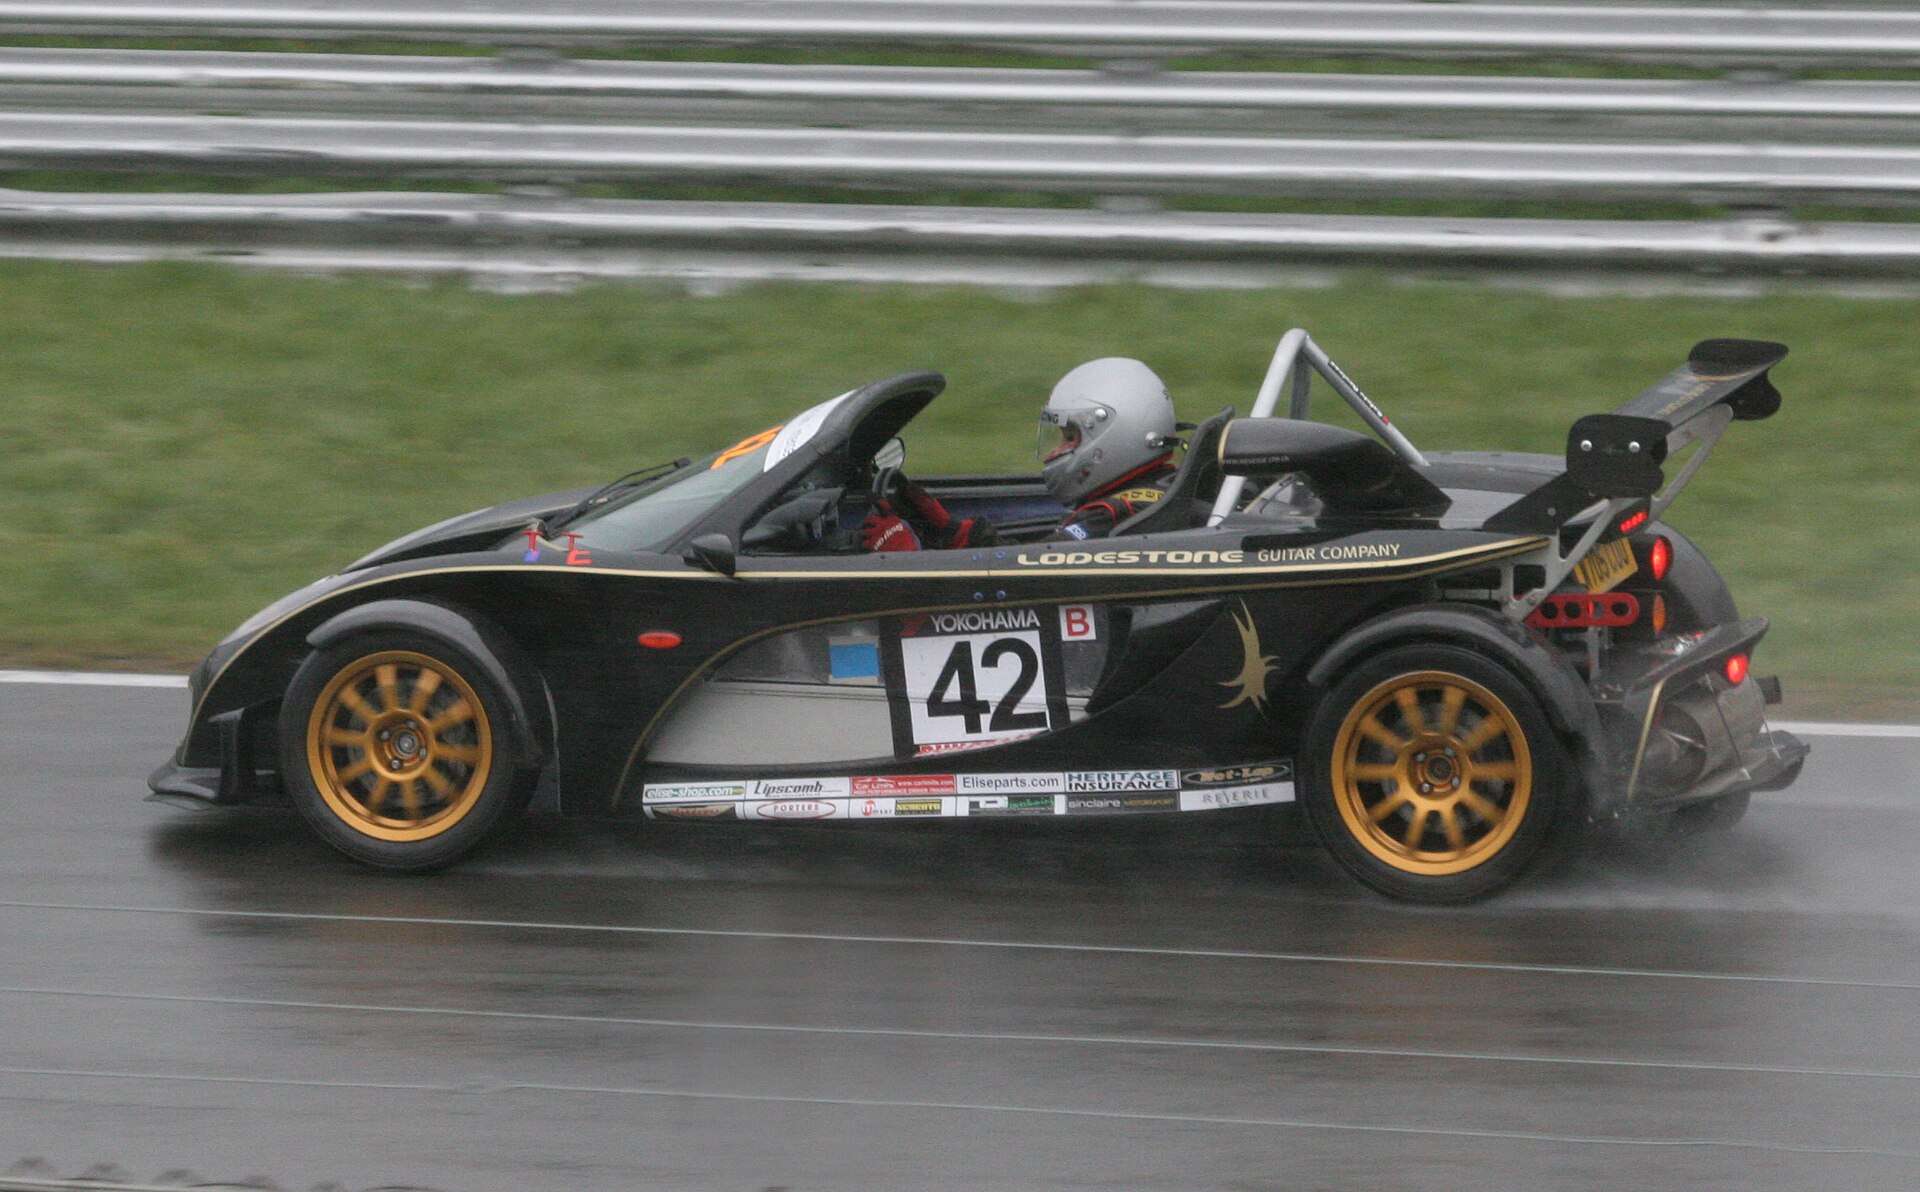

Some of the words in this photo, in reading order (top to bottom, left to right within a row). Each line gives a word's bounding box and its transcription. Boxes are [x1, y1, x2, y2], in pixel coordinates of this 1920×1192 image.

[1017, 550, 1244, 566] LODESTONE
[1257, 548, 1316, 562] GUITAR
[1320, 543, 1401, 561] COMPANY
[931, 609, 1041, 632] YOKOHAMA
[1065, 607, 1090, 637] B
[926, 637, 1049, 735] 42
[962, 774, 1059, 790] Eliseparts.com
[1068, 770, 1174, 782] HERITAGE
[1068, 780, 1175, 791] INSURANCE
[754, 780, 823, 797] Lipscomb
